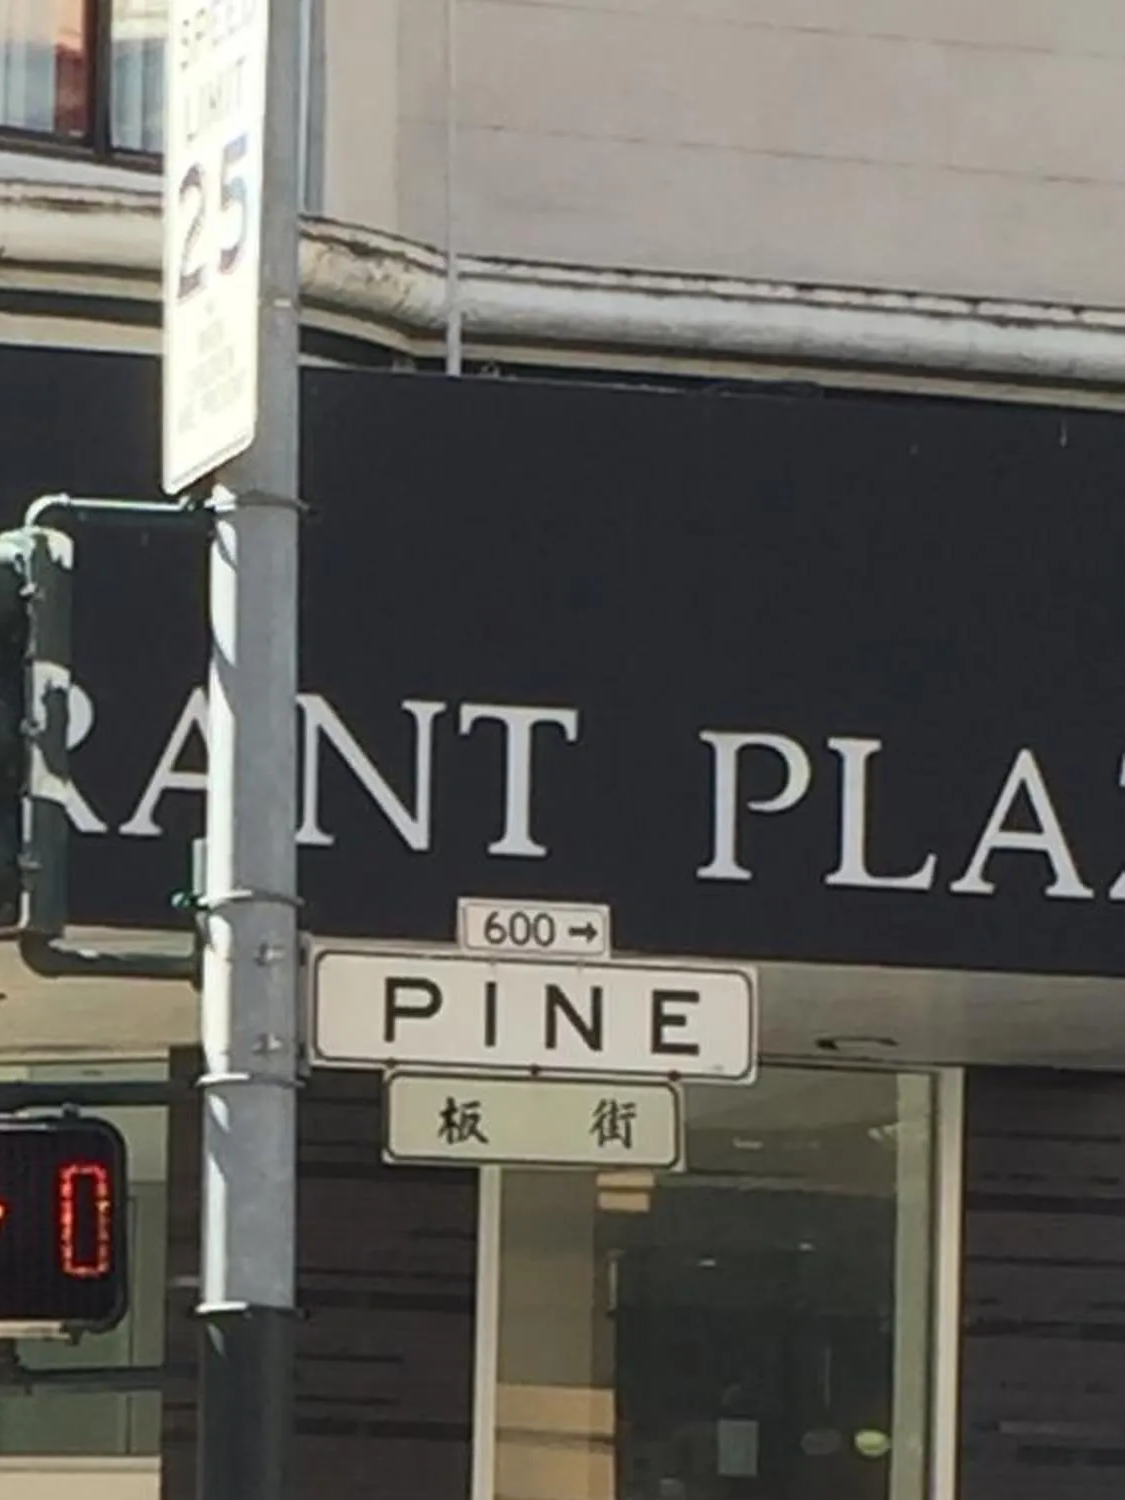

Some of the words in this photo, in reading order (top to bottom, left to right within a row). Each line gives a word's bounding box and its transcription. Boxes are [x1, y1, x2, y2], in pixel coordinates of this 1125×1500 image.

[177, 132, 248, 299] 25
[697, 731, 1125, 899] PLA
[484, 911, 556, 948] 600
[384, 976, 700, 1056] PINE
